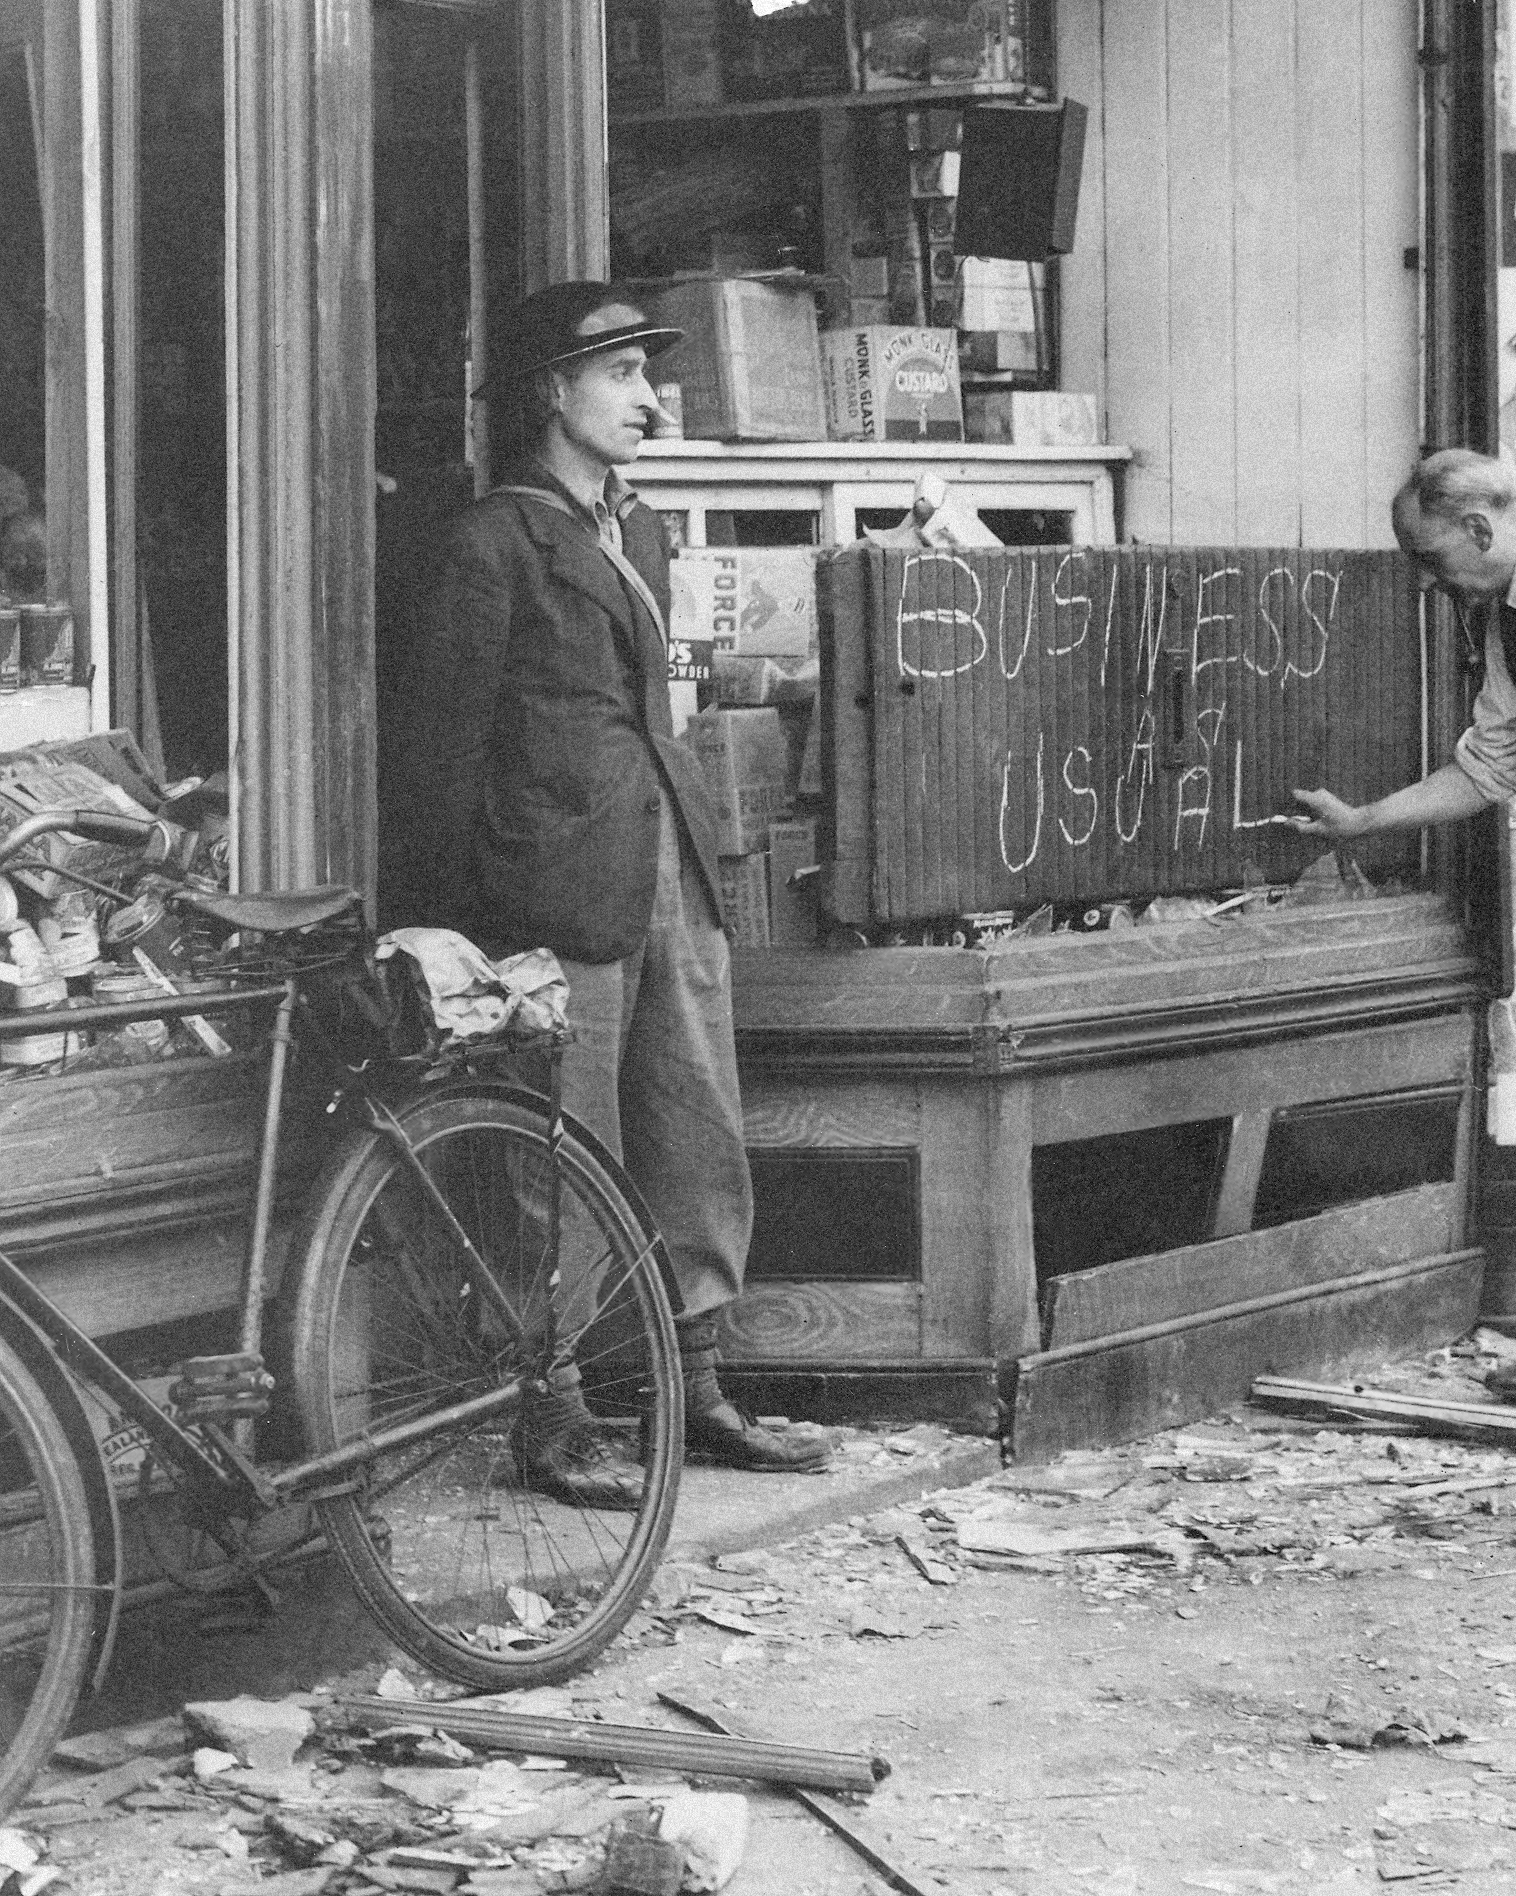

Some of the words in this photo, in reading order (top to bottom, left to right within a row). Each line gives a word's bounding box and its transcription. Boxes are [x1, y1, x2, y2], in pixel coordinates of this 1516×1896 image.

[844, 357, 859, 419] CUSTARD
[855, 333, 870, 380] MONK
[895, 370, 948, 394] CUSTARD
[860, 389, 875, 437] GLASS
[713, 555, 738, 651] FORCE
[897, 552, 1344, 695] BUSINESS
[1127, 702, 1227, 785] AS
[1000, 732, 1312, 873] USUAL
